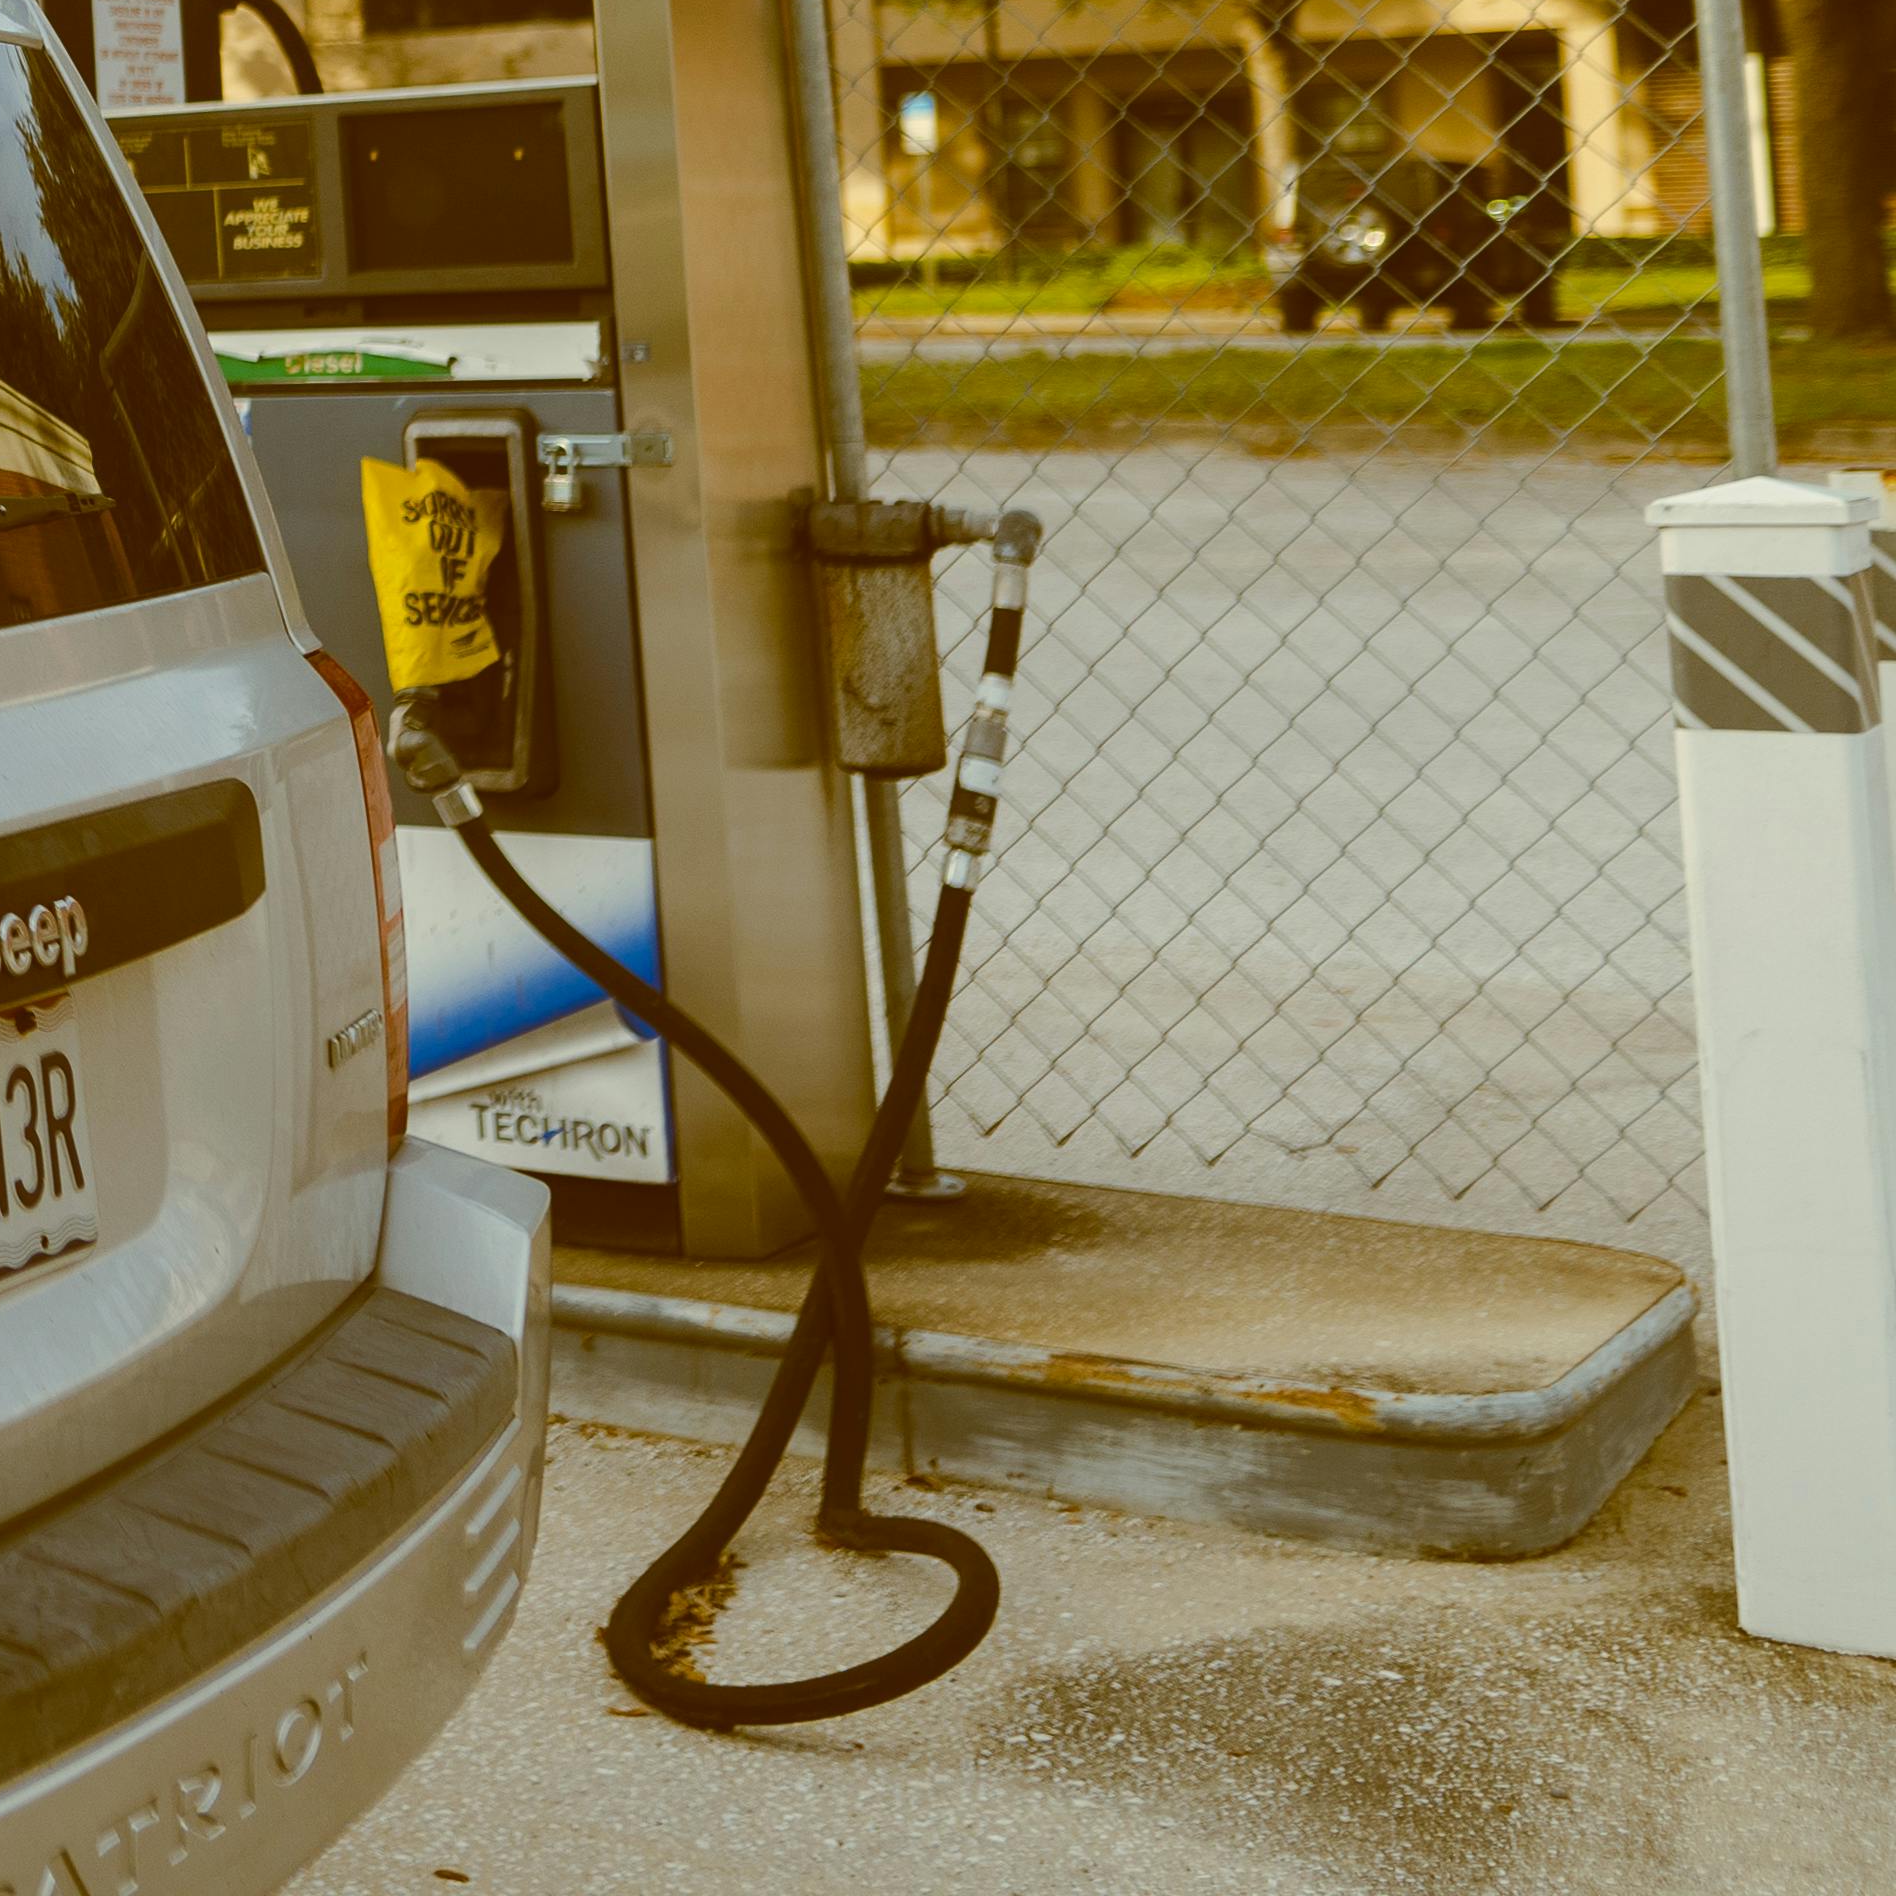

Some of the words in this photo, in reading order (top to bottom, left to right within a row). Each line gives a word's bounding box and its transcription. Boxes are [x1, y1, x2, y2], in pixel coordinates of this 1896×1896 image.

[253, 195, 280, 213] WE
[224, 206, 310, 226] APPRECIATE
[246, 222, 292, 237] YOUR
[233, 232, 305, 250] BUSINESS
[284, 352, 362, 375] Diesel
[469, 1103, 650, 1161] TECHRON
